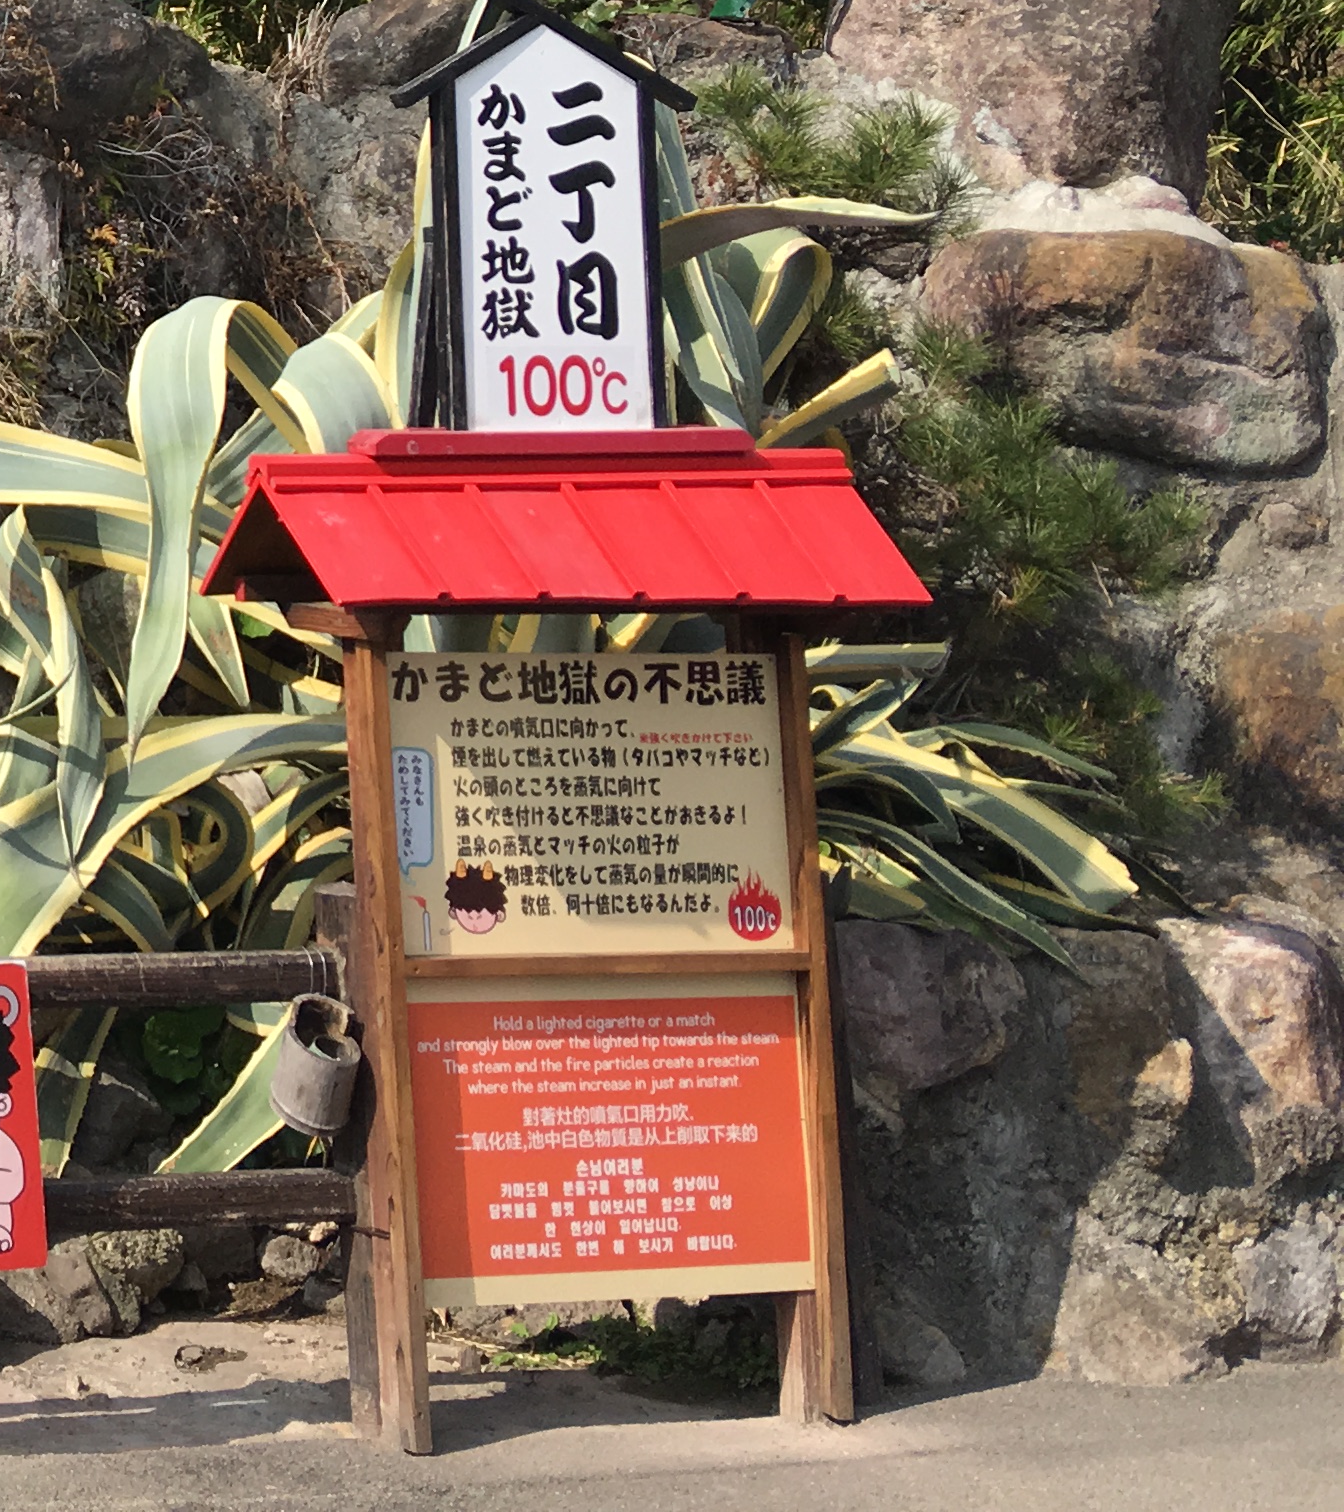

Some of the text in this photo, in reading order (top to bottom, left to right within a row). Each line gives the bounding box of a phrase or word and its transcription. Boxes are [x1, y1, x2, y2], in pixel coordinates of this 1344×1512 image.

[477, 83, 540, 342] かまど地獄
[547, 81, 620, 341] 二丁目
[390, 659, 766, 706] かまど地獄の不思議
[453, 775, 662, 798] 火の頭のところを蒸気に向けて
[456, 833, 680, 858] 温泉の蒸気とマッチの火の粒子が
[504, 862, 740, 887] 物理変化をして蒸気の量が瞬間的に
[493, 1012, 716, 1034] Hold a lighted cigarette or a match
[417, 1037, 441, 1053] and
[443, 1036, 499, 1056] strongly
[502, 1035, 533, 1051] blow
[535, 1038, 565, 1051] over
[568, 1034, 591, 1050] the
[593, 1033, 639, 1054] lighted
[642, 1033, 660, 1052] tip
[662, 1031, 714, 1047] towards
[716, 1031, 739, 1046] the
[442, 1053, 760, 1076] The steam and the fire particles create a reaction
[467, 1078, 509, 1095] where
[511, 1078, 534, 1094] the
[536, 1080, 577, 1093] steam
[579, 1077, 632, 1092] increase
[635, 1076, 647, 1090] in
[650, 1075, 675, 1095] just
[678, 1077, 694, 1089] an
[575, 1157, 644, 1177] 손님여러분
